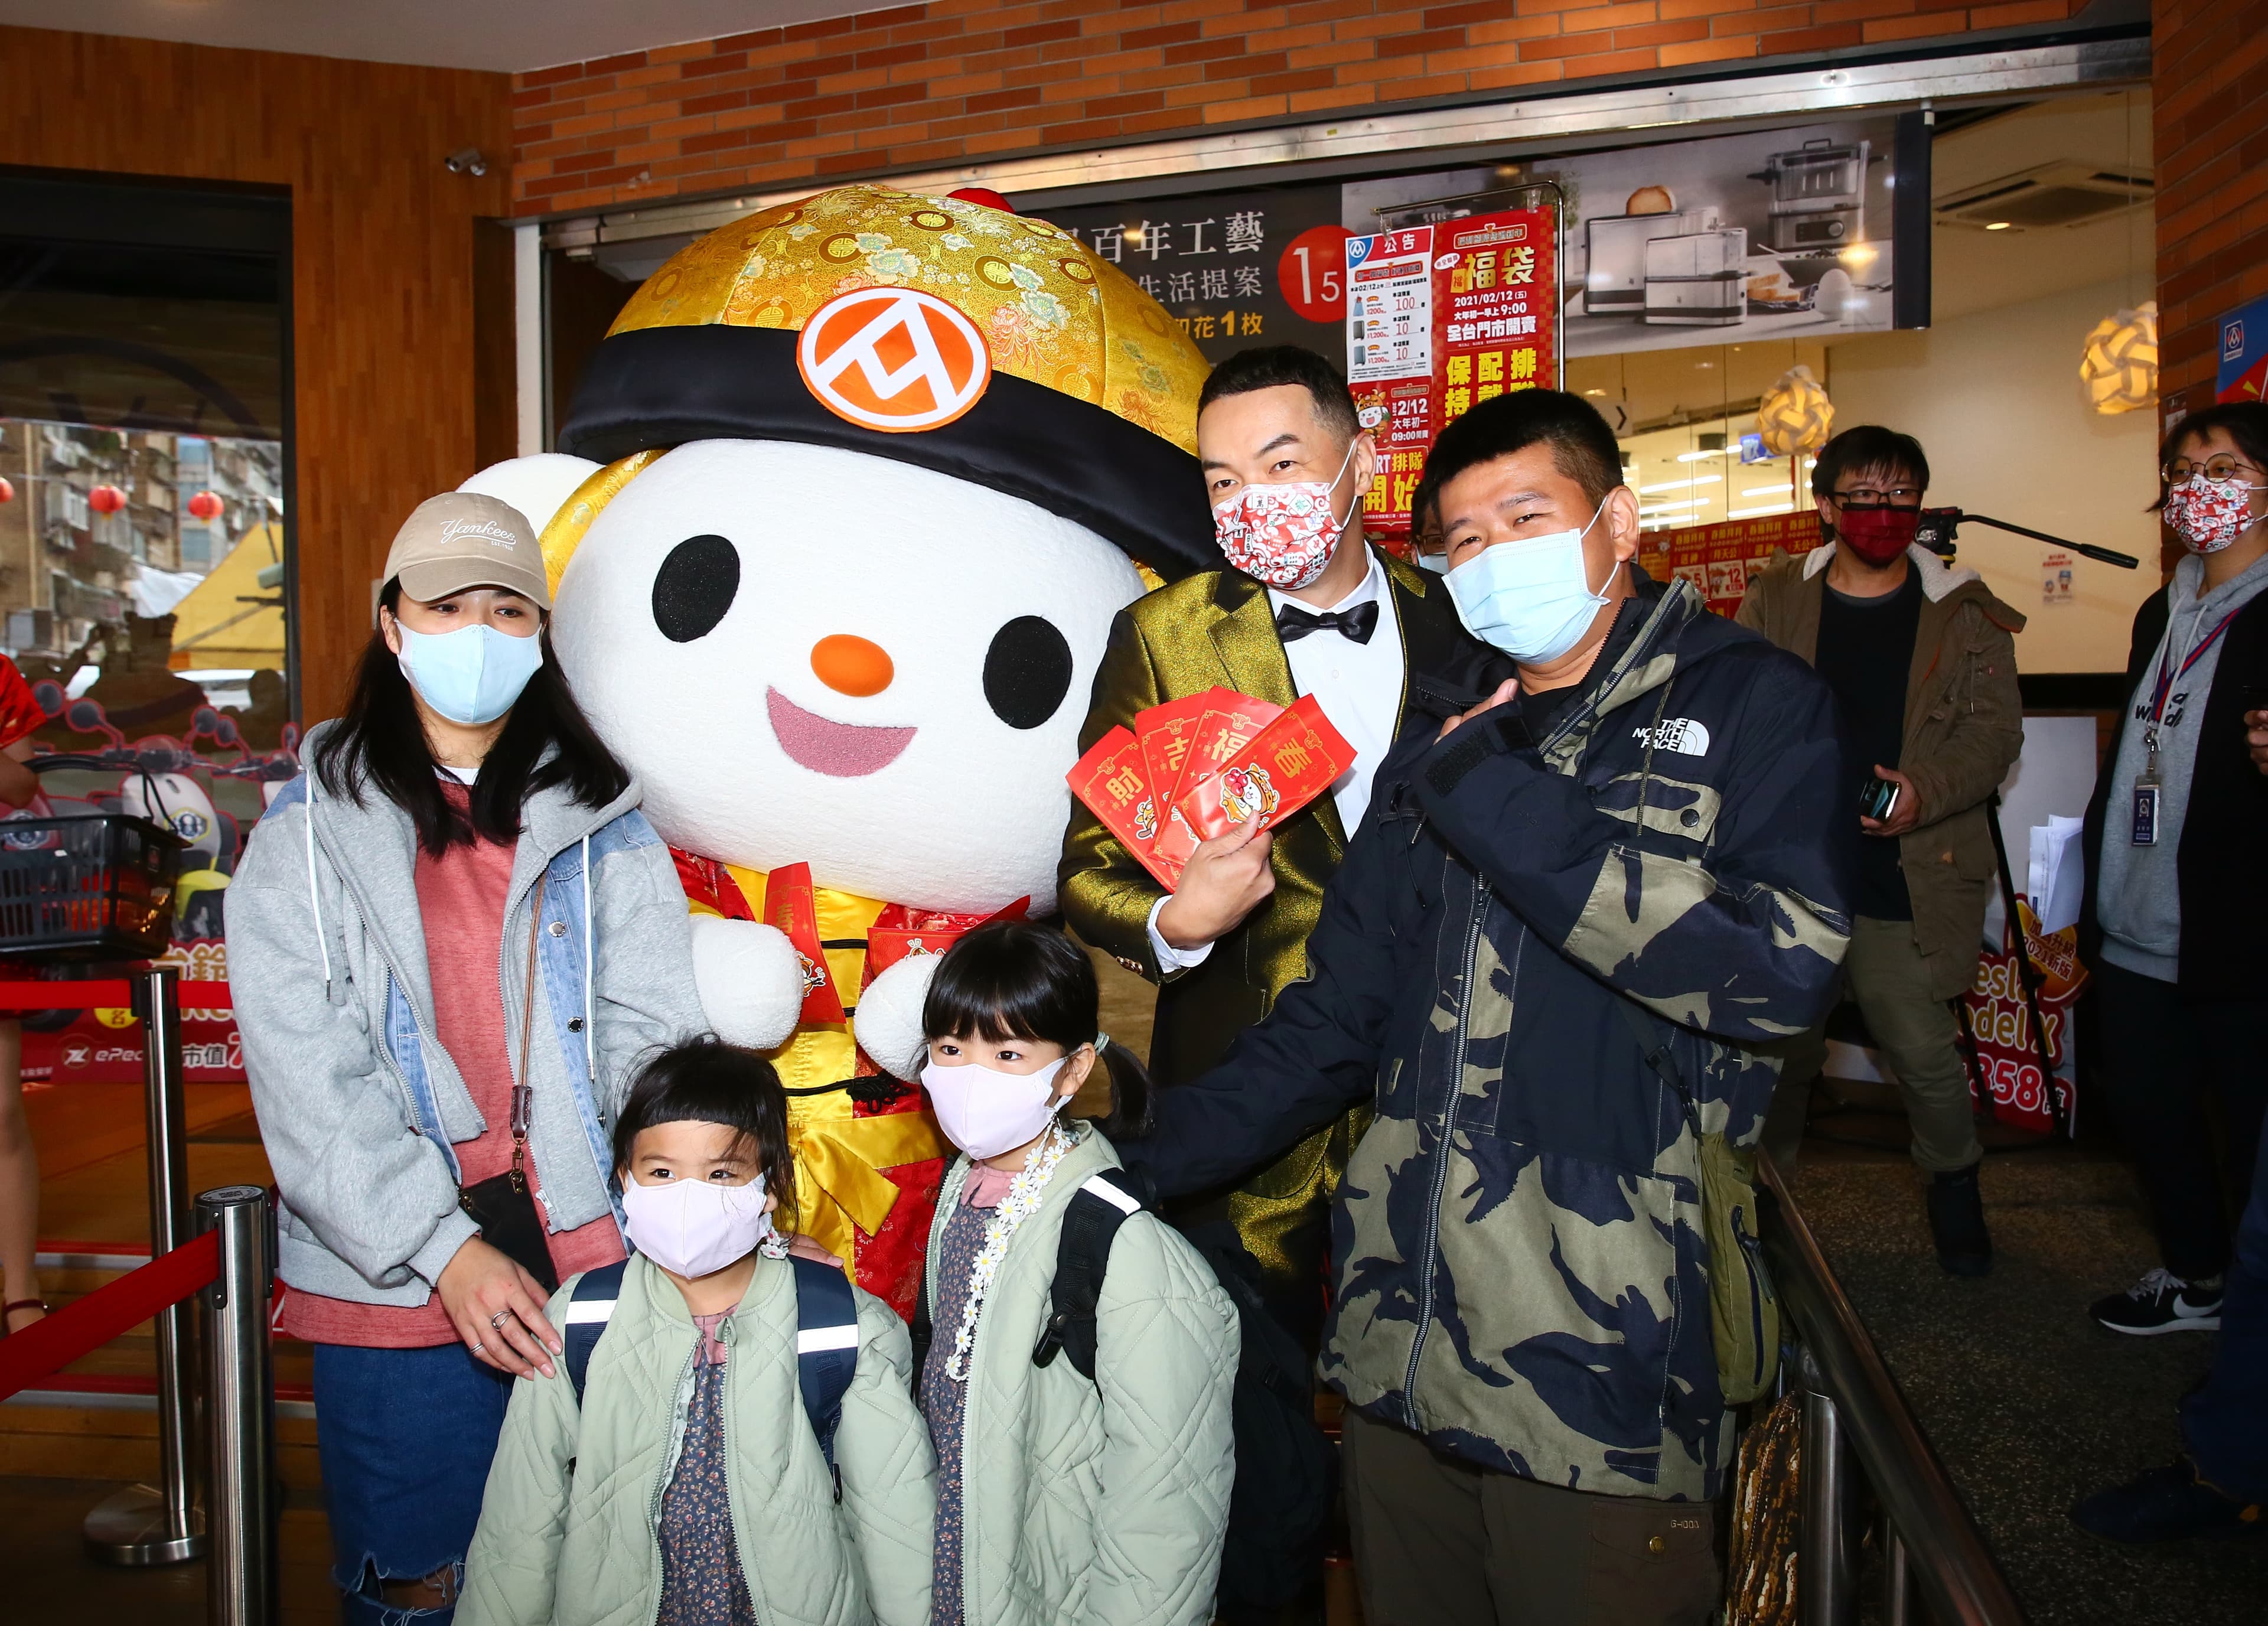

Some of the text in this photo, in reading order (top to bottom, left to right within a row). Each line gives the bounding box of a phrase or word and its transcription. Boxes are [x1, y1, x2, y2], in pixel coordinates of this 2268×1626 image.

[1064, 211, 1265, 263] 百年工藝
[1384, 233, 1415, 253] 公告
[1465, 246, 1534, 290] 福袋
[1139, 266, 1263, 303] 生活提案
[1396, 297, 1415, 311] 100
[1455, 291, 1513, 308] 2021/02/12
[1454, 302, 1527, 321] 大年初一早上 9:00
[1396, 322, 1409, 335] 10
[1447, 315, 1536, 343] 全台門市開賣
[1396, 347, 1408, 360] 10
[1445, 356, 1471, 427] 保持
[1397, 398, 1428, 416] 2/12
[1392, 417, 1428, 430] 大年初一
[1392, 451, 1422, 472] 排隊
[1363, 473, 1419, 513] 開始
[440, 518, 516, 545] Yankees
[1693, 573, 1702, 588] 5
[1728, 569, 1741, 584] 12
[1661, 718, 1689, 729] THE
[1632, 727, 1684, 741] NORTH
[1211, 728, 1251, 763] 福
[1641, 738, 1679, 752] FACE
[1274, 738, 1312, 778] 春
[1106, 765, 1144, 807] 財
[2030, 919, 2075, 960] 加升級
